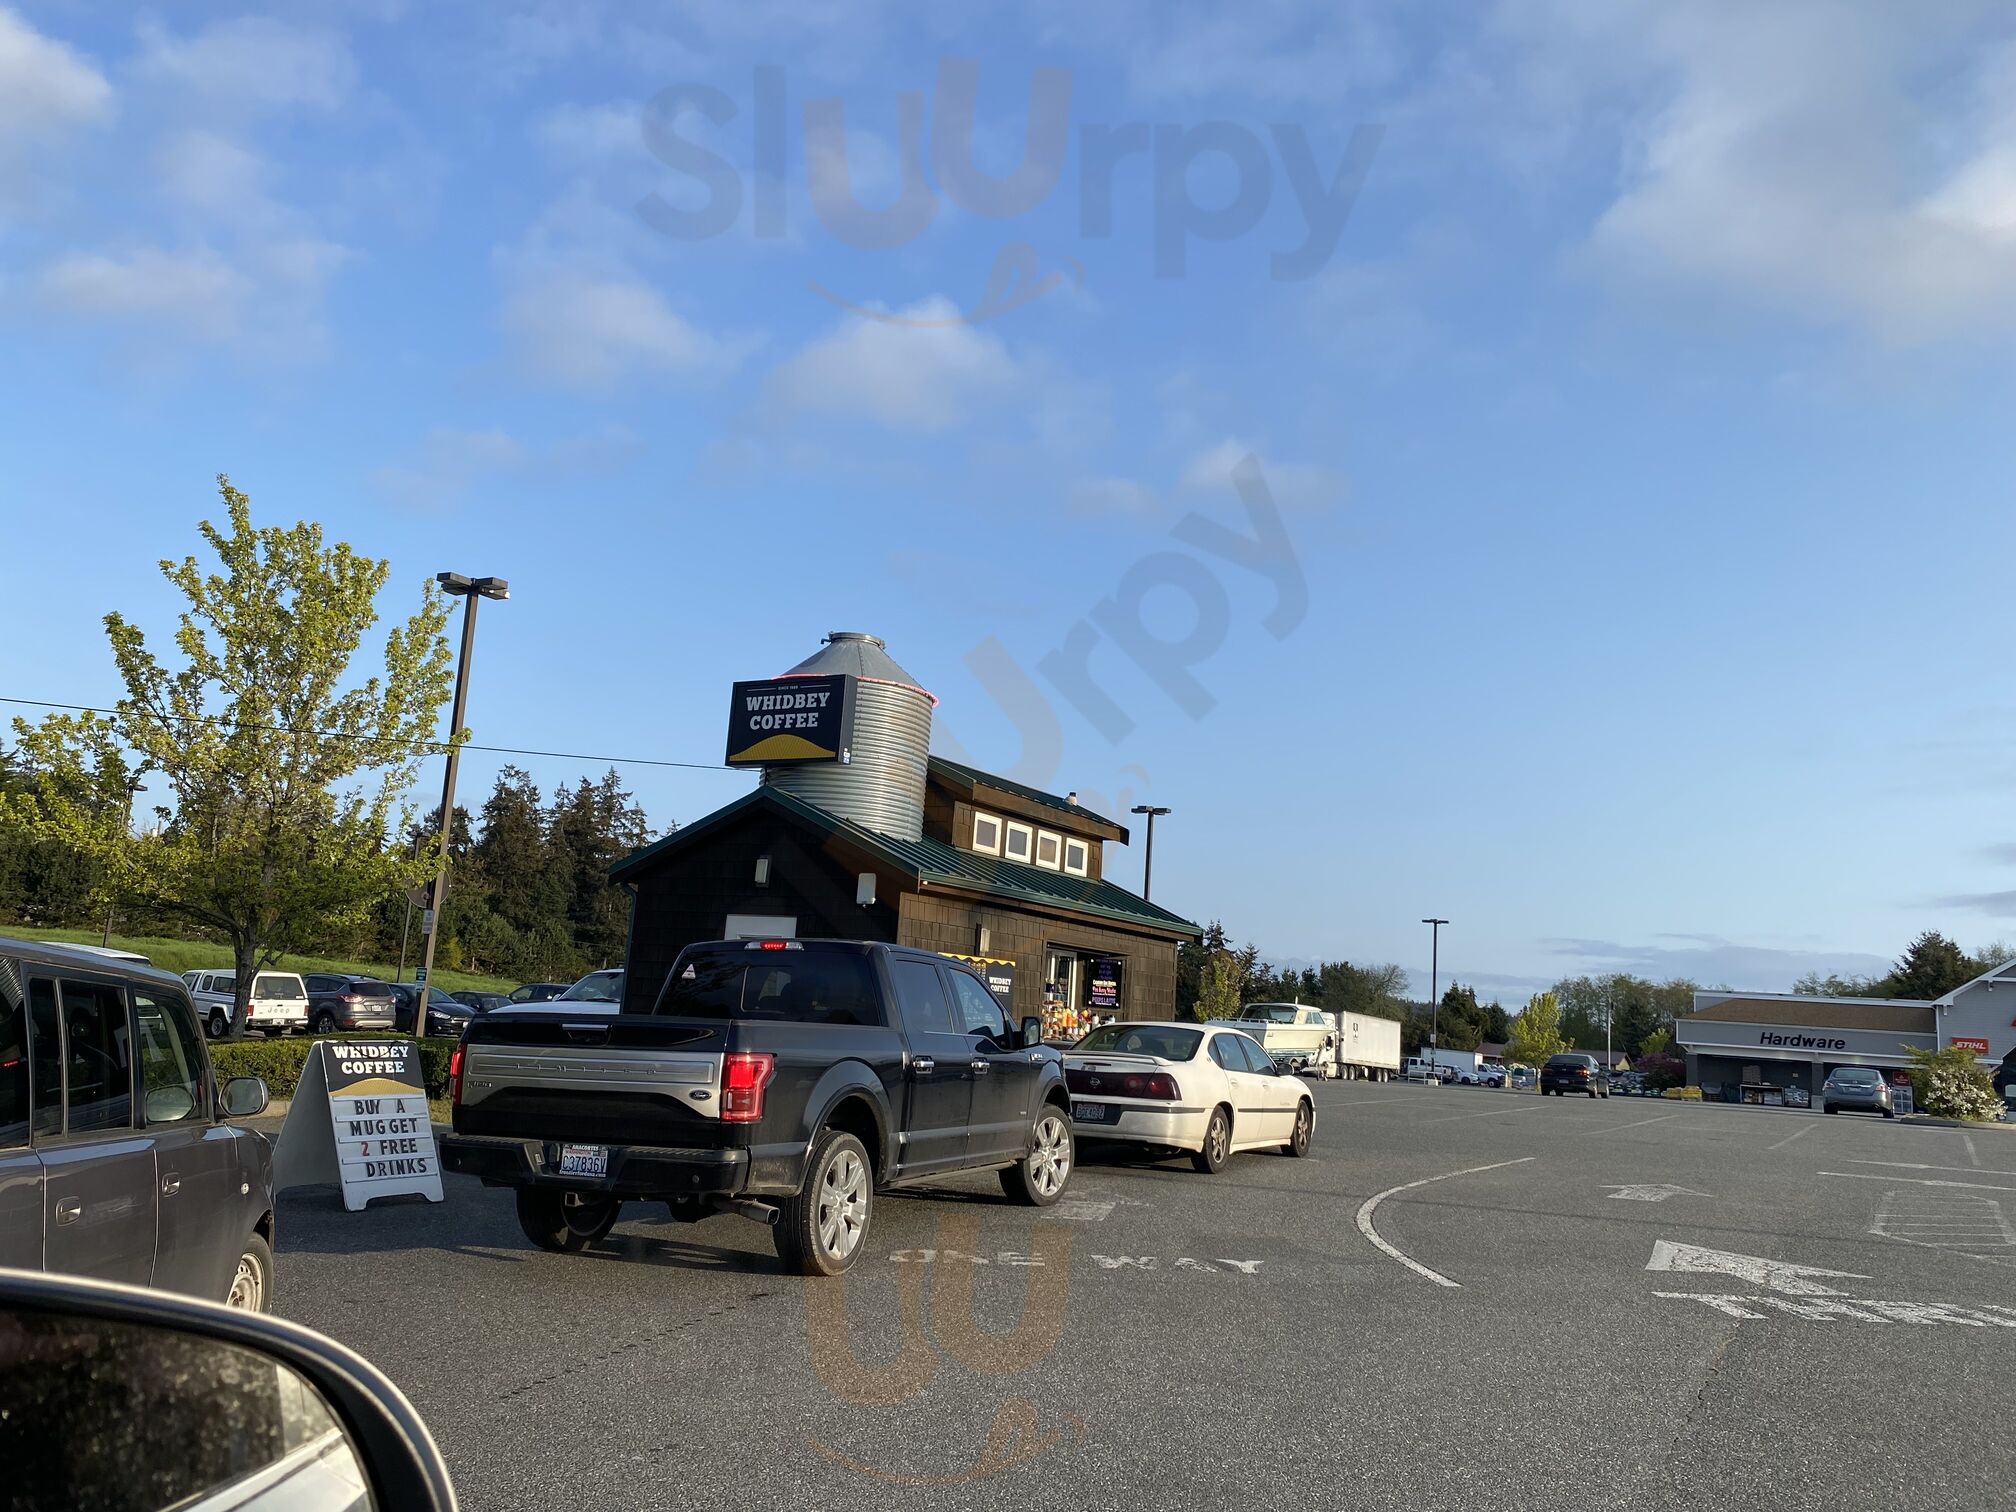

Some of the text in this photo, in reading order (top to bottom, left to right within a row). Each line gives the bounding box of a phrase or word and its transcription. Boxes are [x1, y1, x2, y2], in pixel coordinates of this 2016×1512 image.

[746, 692, 831, 711] WHIDBEY
[749, 712, 819, 730] COFFEE
[989, 976, 1012, 986] WHIDBEY
[990, 984, 1009, 993] COFFEE
[1760, 1032, 1846, 1050] Hardware
[1956, 1041, 1987, 1050] STIHL
[332, 1046, 409, 1059] WHIDBEY
[341, 1060, 405, 1075] COFFEE
[354, 1098, 406, 1115] BUY A
[361, 1138, 418, 1156] 2 FREE
[365, 1158, 427, 1178] DRINKS
[562, 1156, 606, 1173] C37836V
[887, 1248, 1265, 1274] ONE WAY
